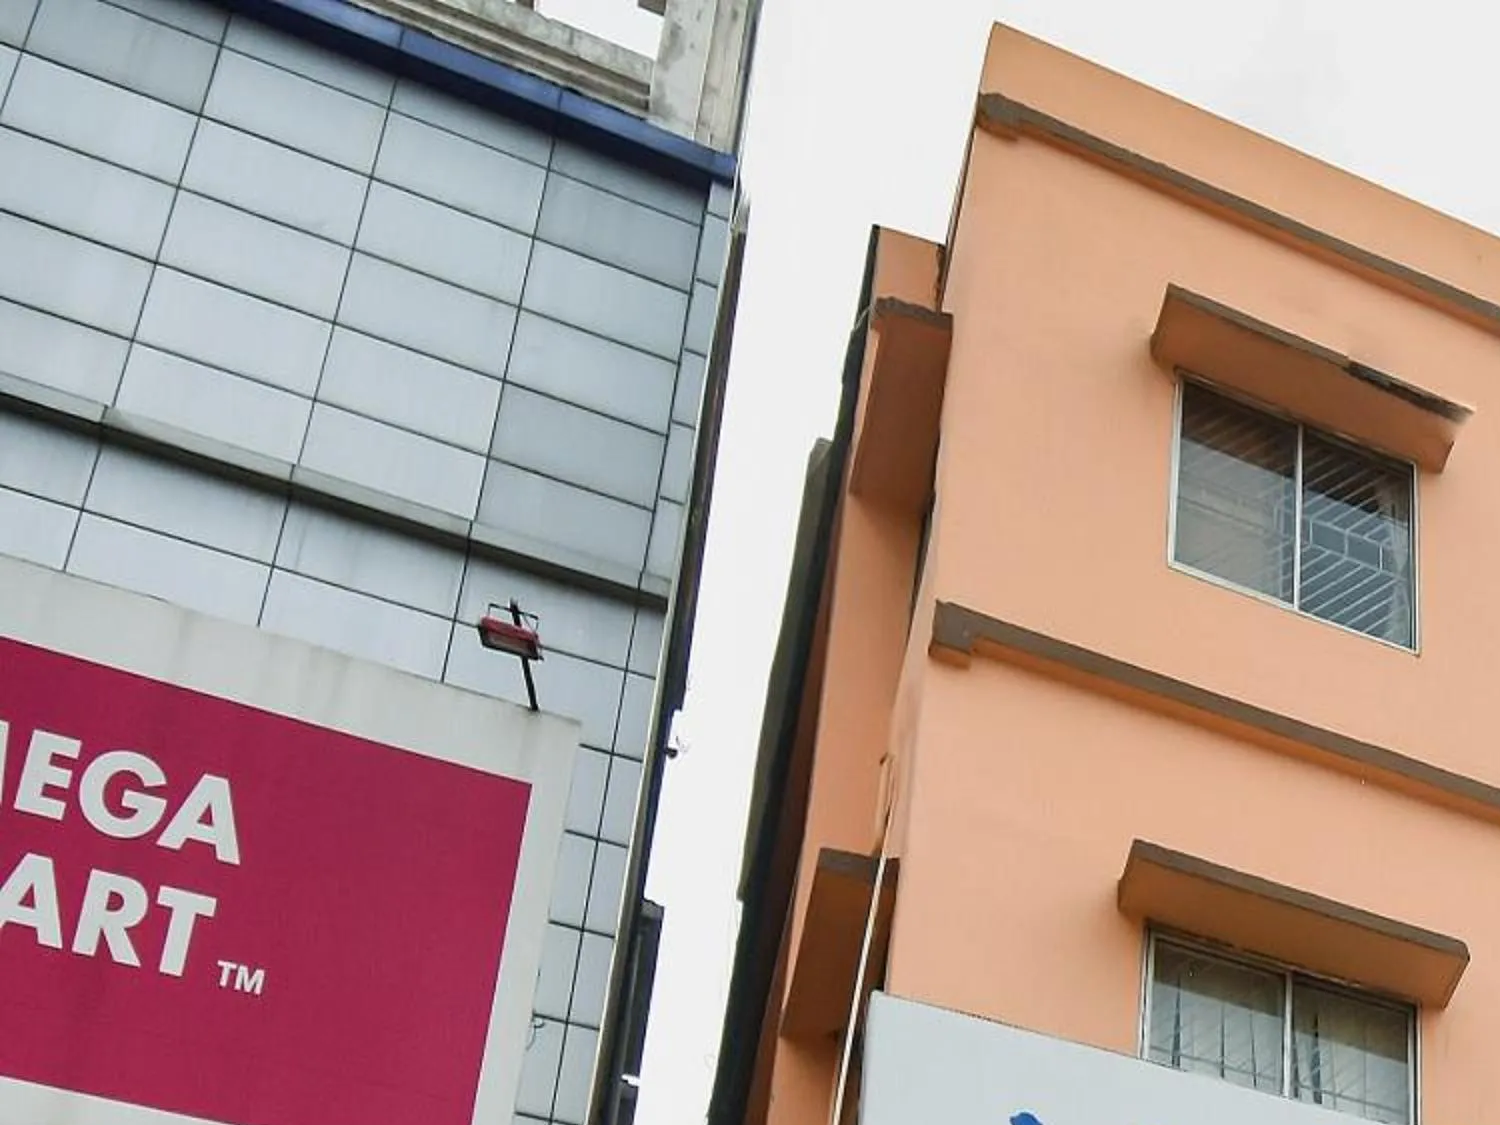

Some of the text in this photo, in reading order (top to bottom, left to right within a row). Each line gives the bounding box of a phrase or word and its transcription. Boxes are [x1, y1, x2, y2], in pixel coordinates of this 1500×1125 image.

[0, 719, 241, 866] EGA
[0, 852, 265, 996] ART TM
